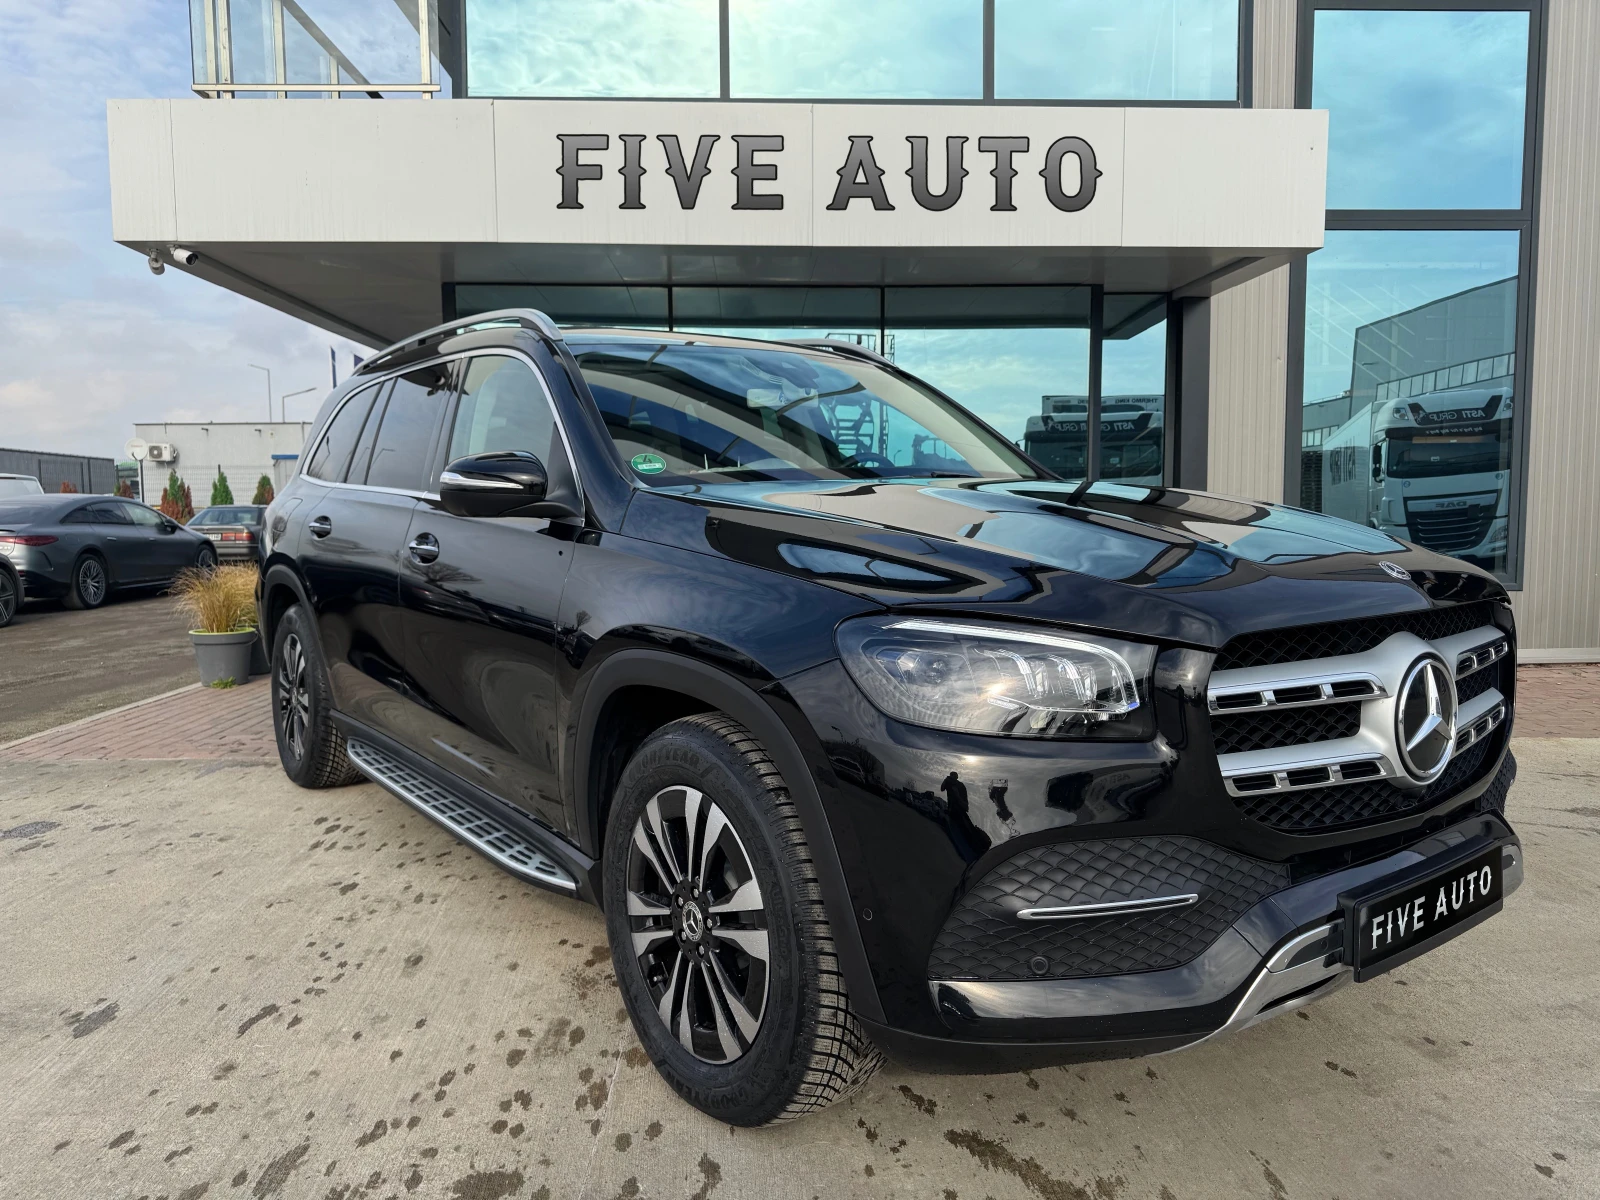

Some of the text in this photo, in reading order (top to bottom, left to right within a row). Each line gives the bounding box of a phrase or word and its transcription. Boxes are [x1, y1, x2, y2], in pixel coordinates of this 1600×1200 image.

[556, 134, 1103, 212] FIVE AUTO
[1371, 865, 1492, 950] FIVE AUTO
